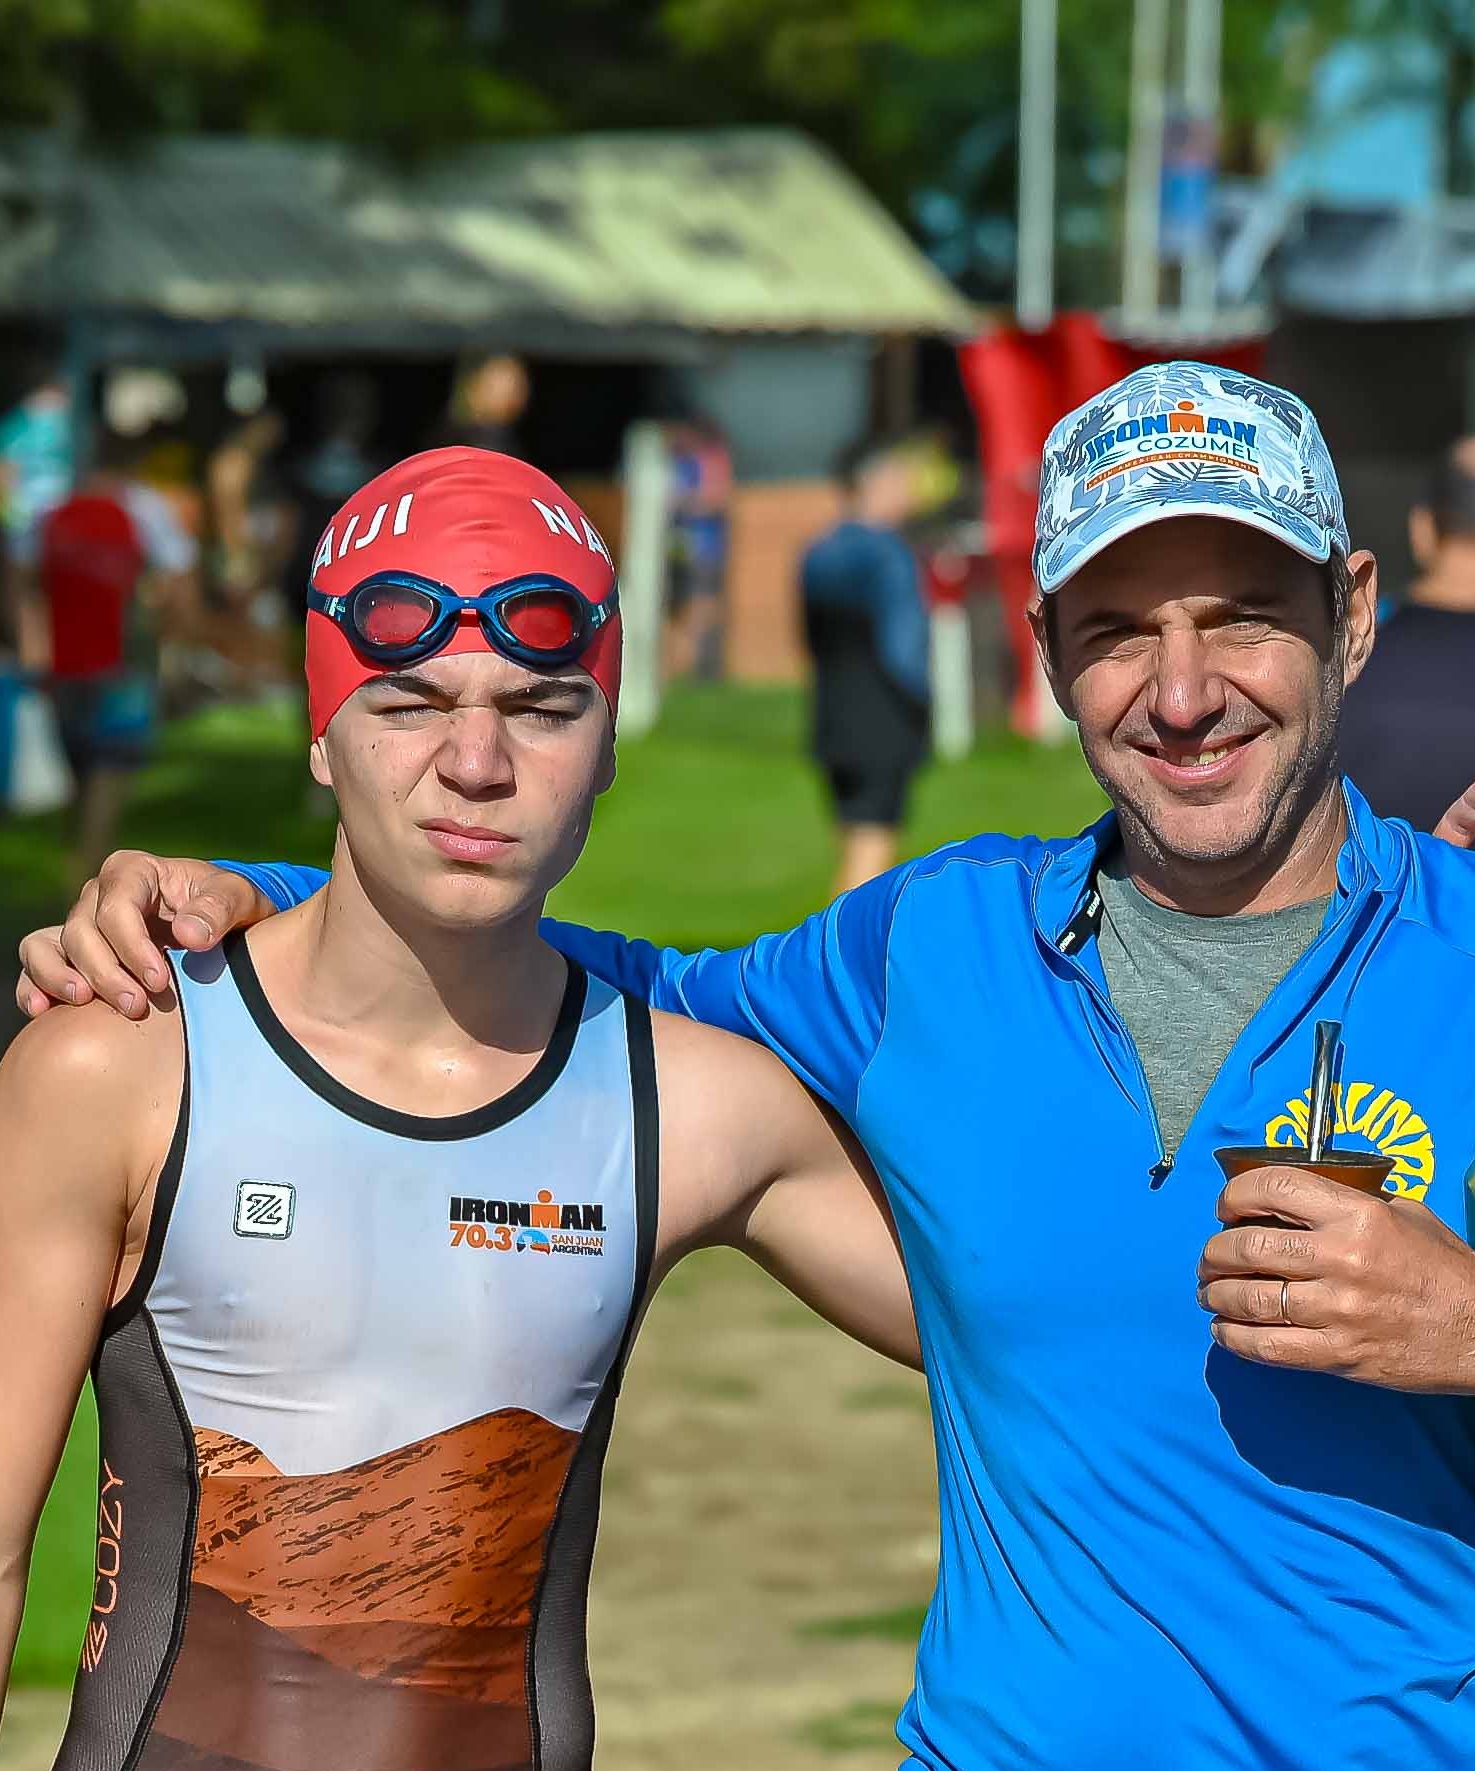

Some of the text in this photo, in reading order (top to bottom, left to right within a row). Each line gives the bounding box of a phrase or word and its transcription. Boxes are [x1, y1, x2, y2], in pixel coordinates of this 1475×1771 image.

[1085, 401, 1257, 464] IRONMAN
[1137, 436, 1259, 464] COZUMEL
[450, 1189, 604, 1231] IRONMAN
[449, 1223, 513, 1252] 70.3
[551, 1234, 604, 1247] SAN JUAN
[551, 1244, 604, 1257] ARGENTINA
